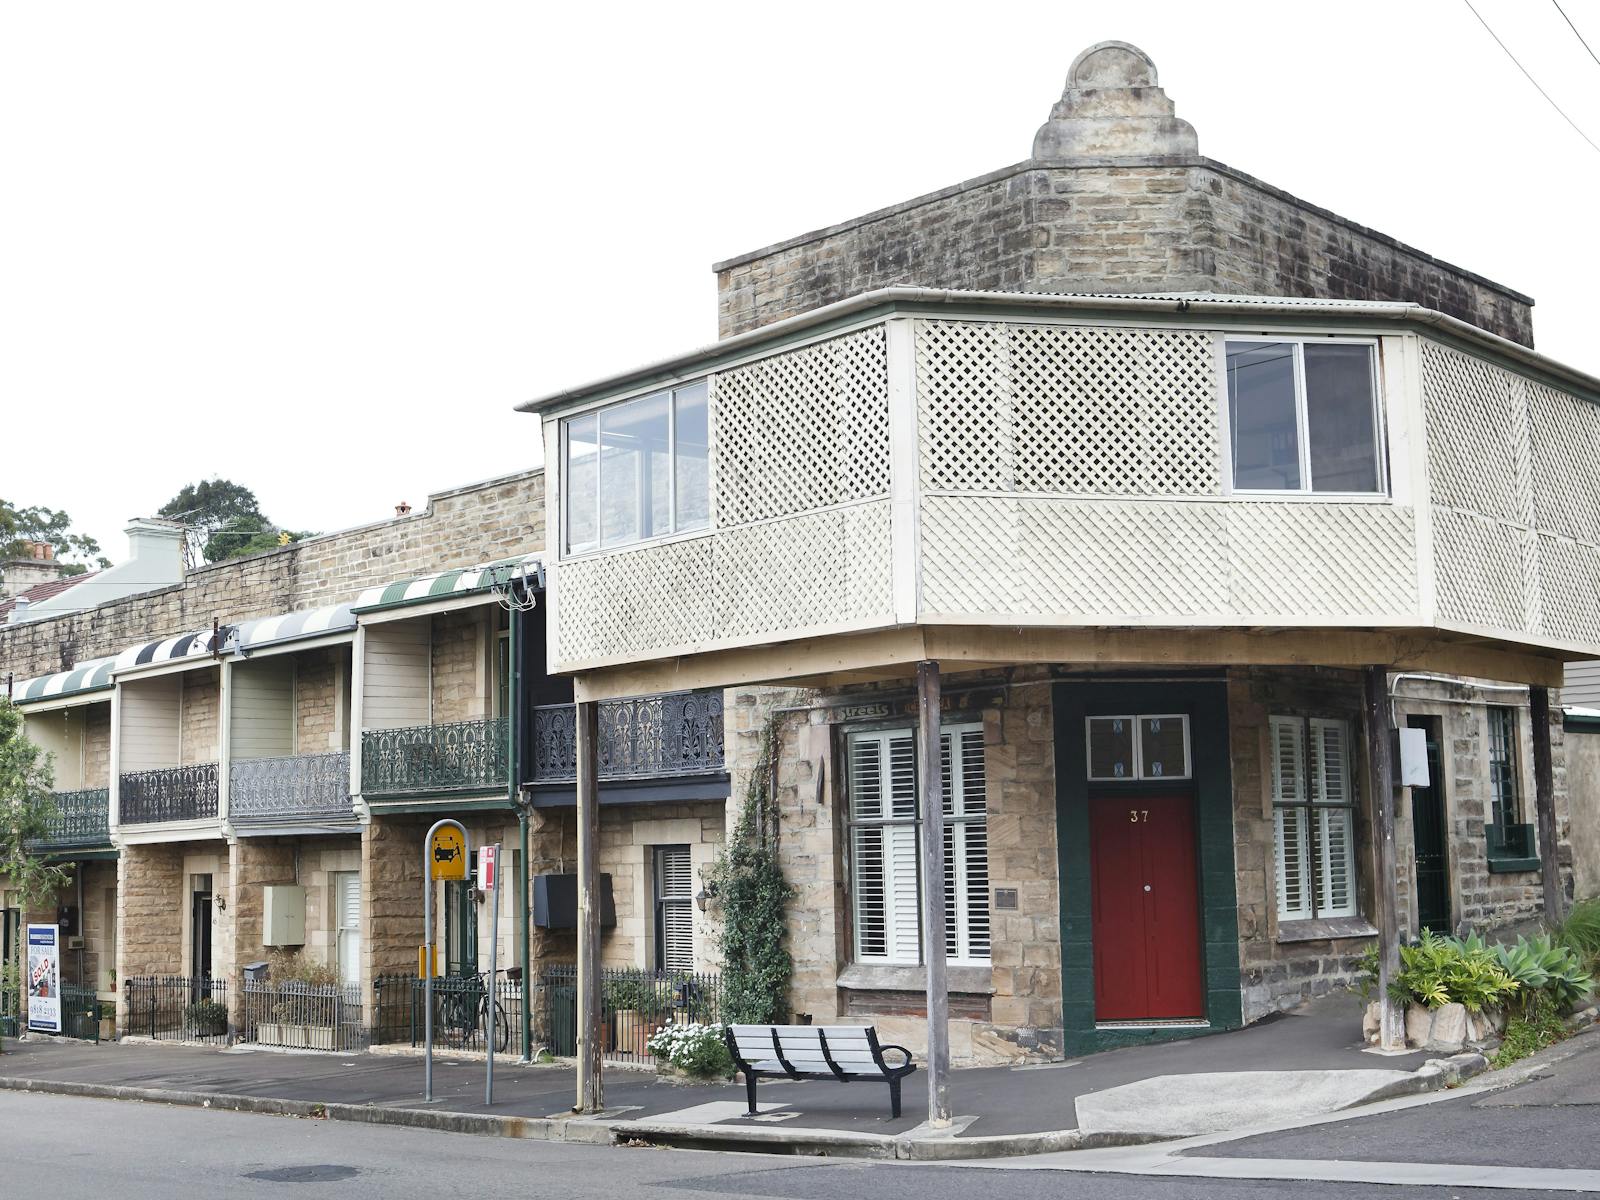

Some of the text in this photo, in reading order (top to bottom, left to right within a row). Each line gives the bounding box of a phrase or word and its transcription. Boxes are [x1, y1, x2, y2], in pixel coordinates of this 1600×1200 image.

[837, 704, 888, 721] Streets
[1130, 810, 1149, 823] 37
[30, 946, 54, 956] FOR SALE
[34, 958, 49, 982] SOLD
